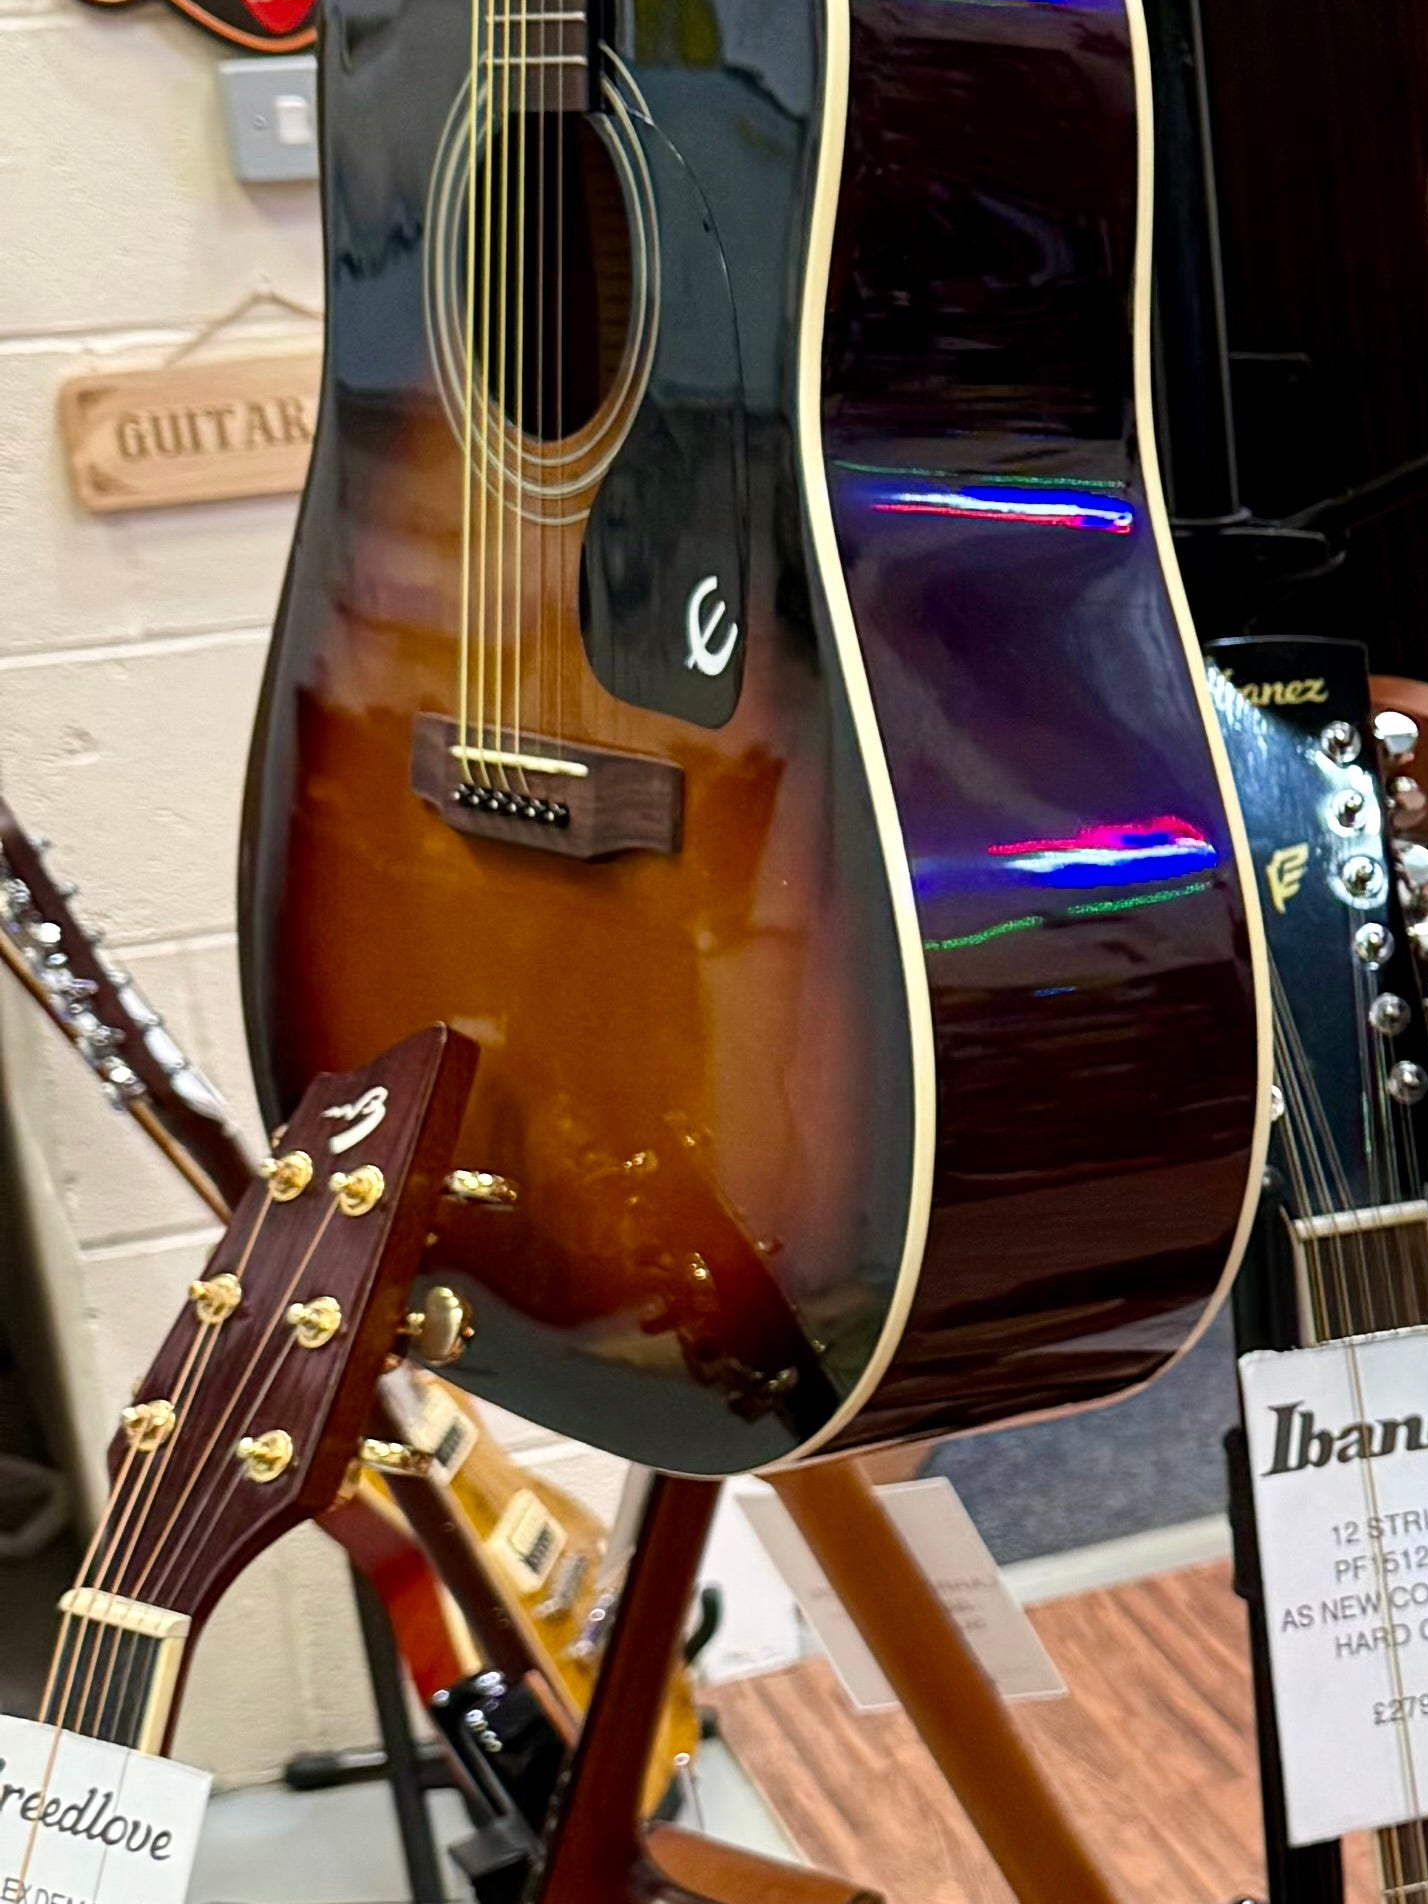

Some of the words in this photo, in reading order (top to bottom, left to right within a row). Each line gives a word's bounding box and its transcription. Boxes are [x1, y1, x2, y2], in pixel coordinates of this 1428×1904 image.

[115, 395, 314, 463] GUITAR
[1329, 1520, 1362, 1547] 12
[1280, 1606, 1315, 1633] AS
[1321, 1591, 1384, 1625] NEW
[1334, 1621, 1414, 1660] HARD
[0, 1757, 174, 1862] reedlove
